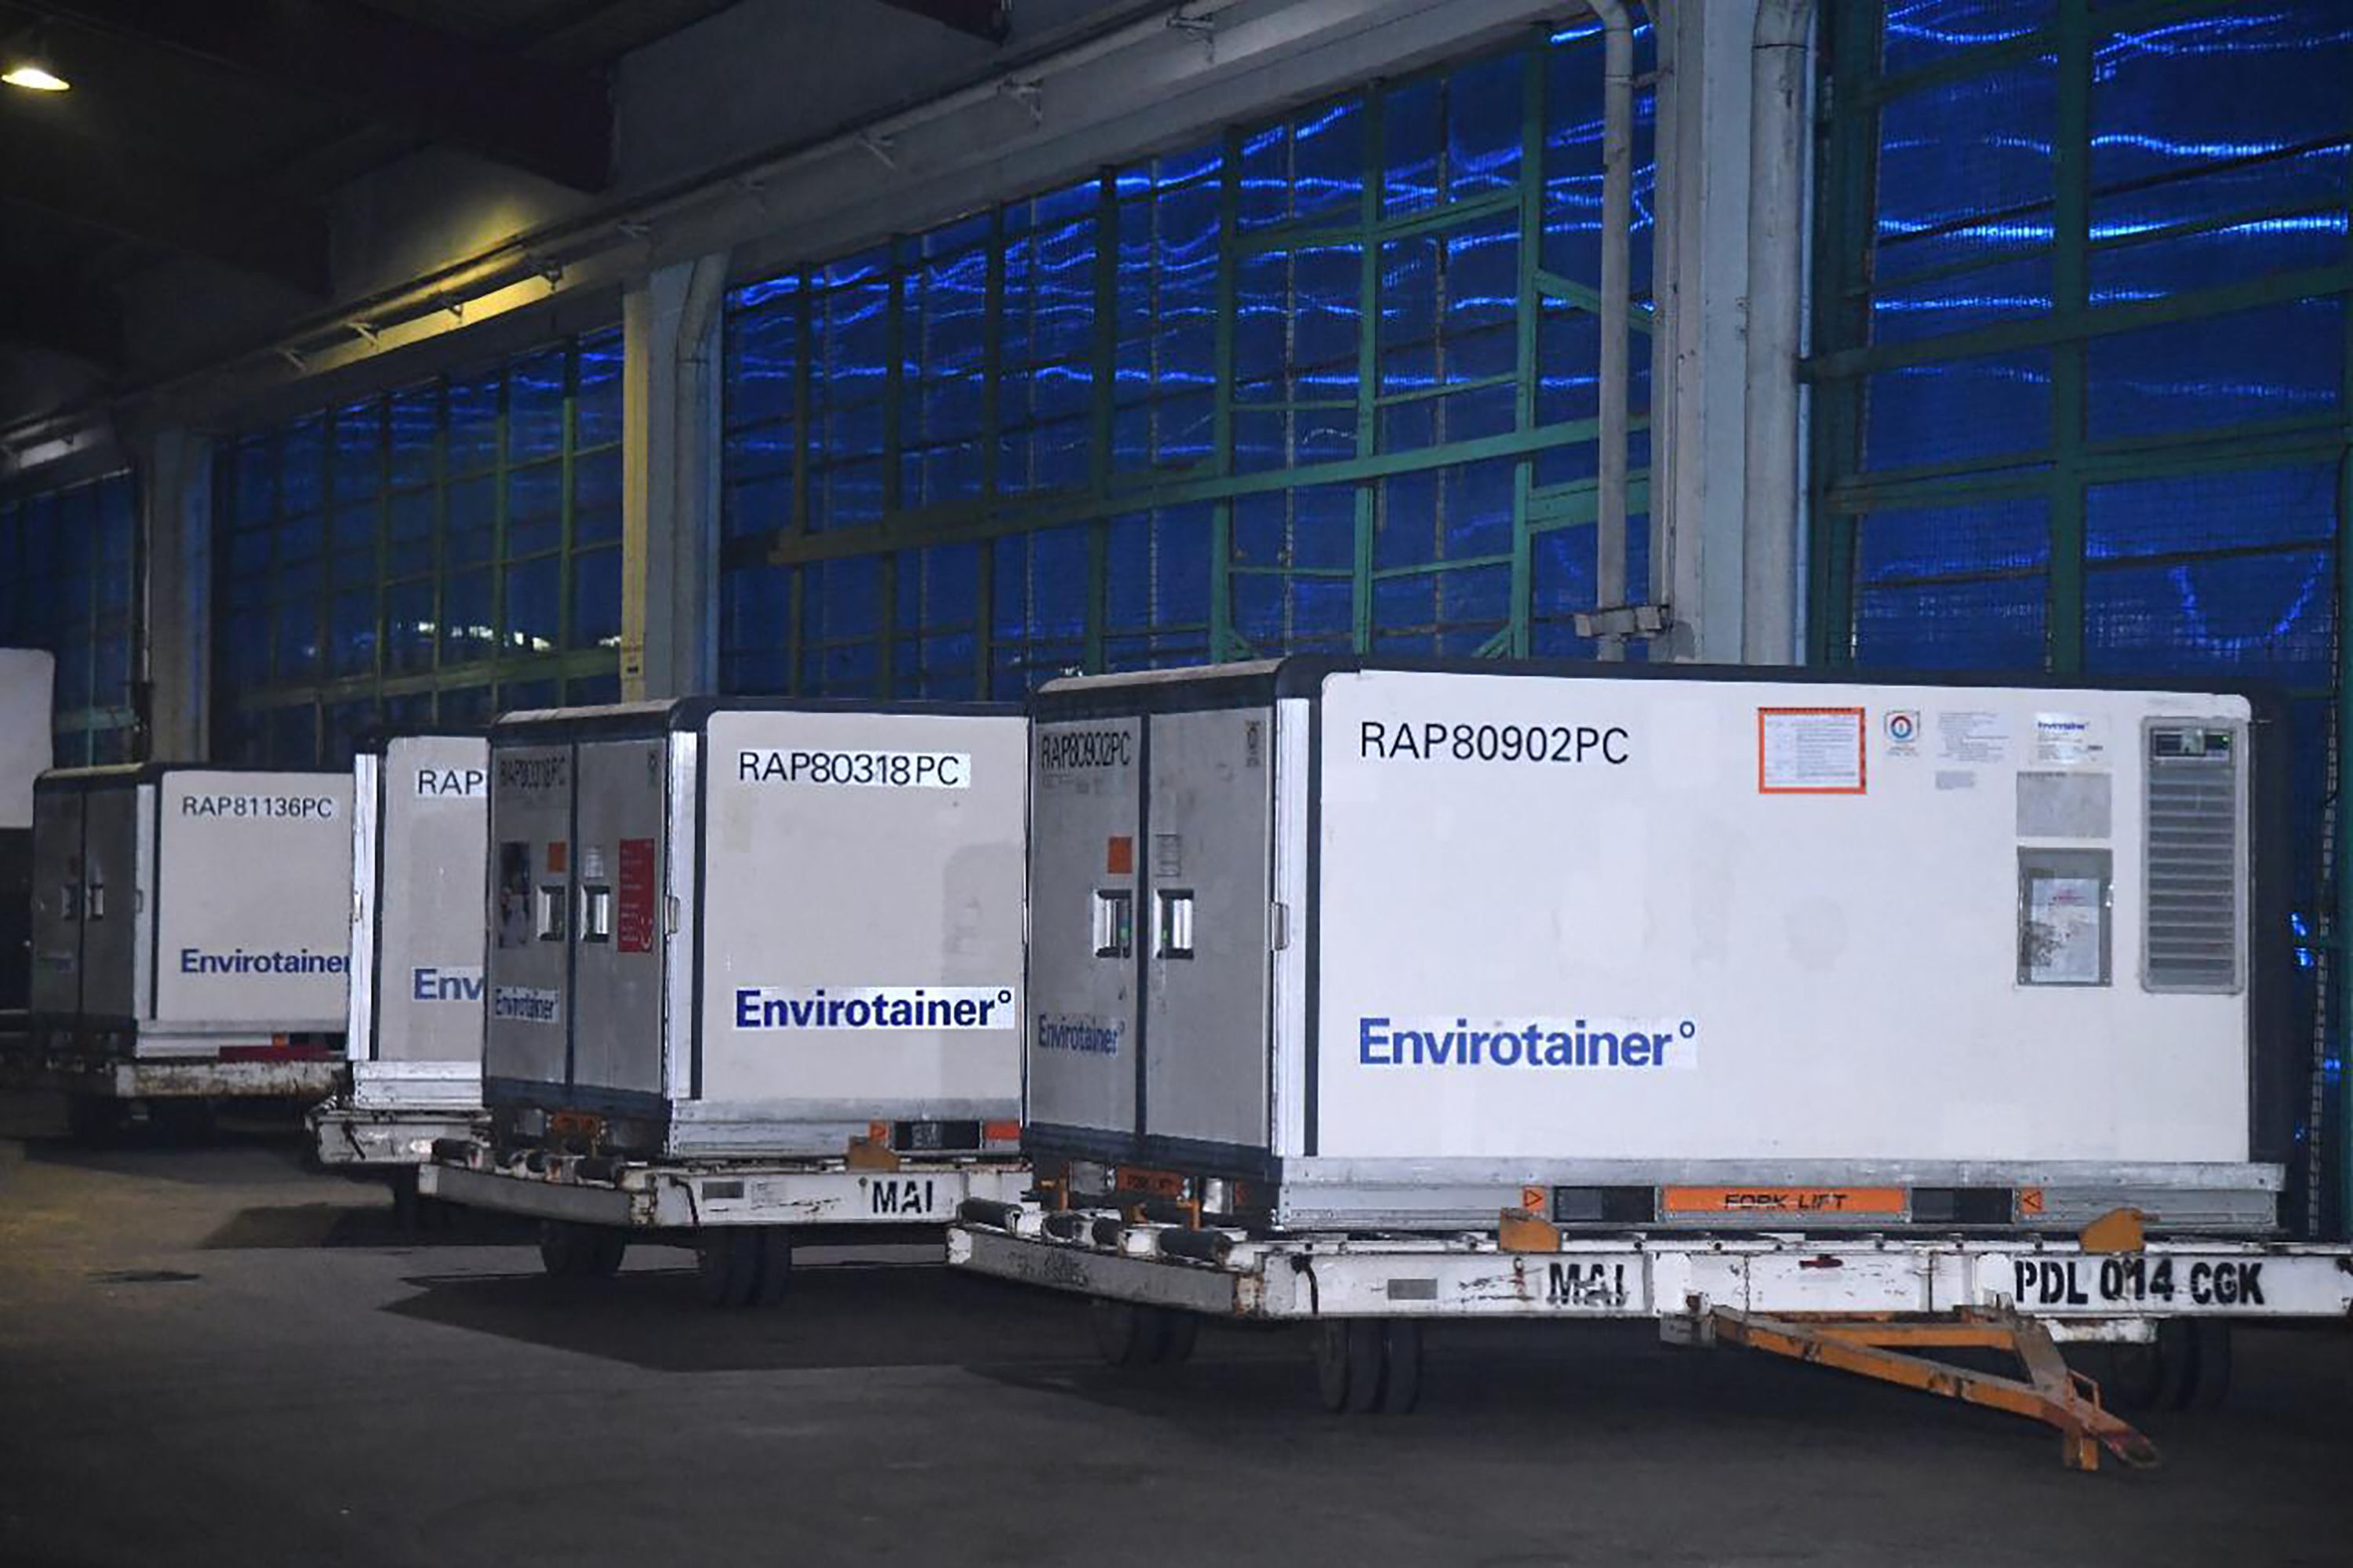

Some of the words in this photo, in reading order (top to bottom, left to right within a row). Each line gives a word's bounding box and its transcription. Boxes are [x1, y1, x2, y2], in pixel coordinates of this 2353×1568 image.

[1360, 722, 1629, 764] RAP80902PC
[739, 751, 959, 785] RAP80318PC
[182, 795, 333, 817] RAP81136PC
[872, 1181, 933, 1214] MAI
[1797, 1194, 1848, 1210] LIFT
[1546, 1262, 1627, 1307] MAI
[2015, 1261, 2088, 1304] PDL
[2100, 1257, 2175, 1302] 014
[2190, 1261, 2265, 1305] CGK
